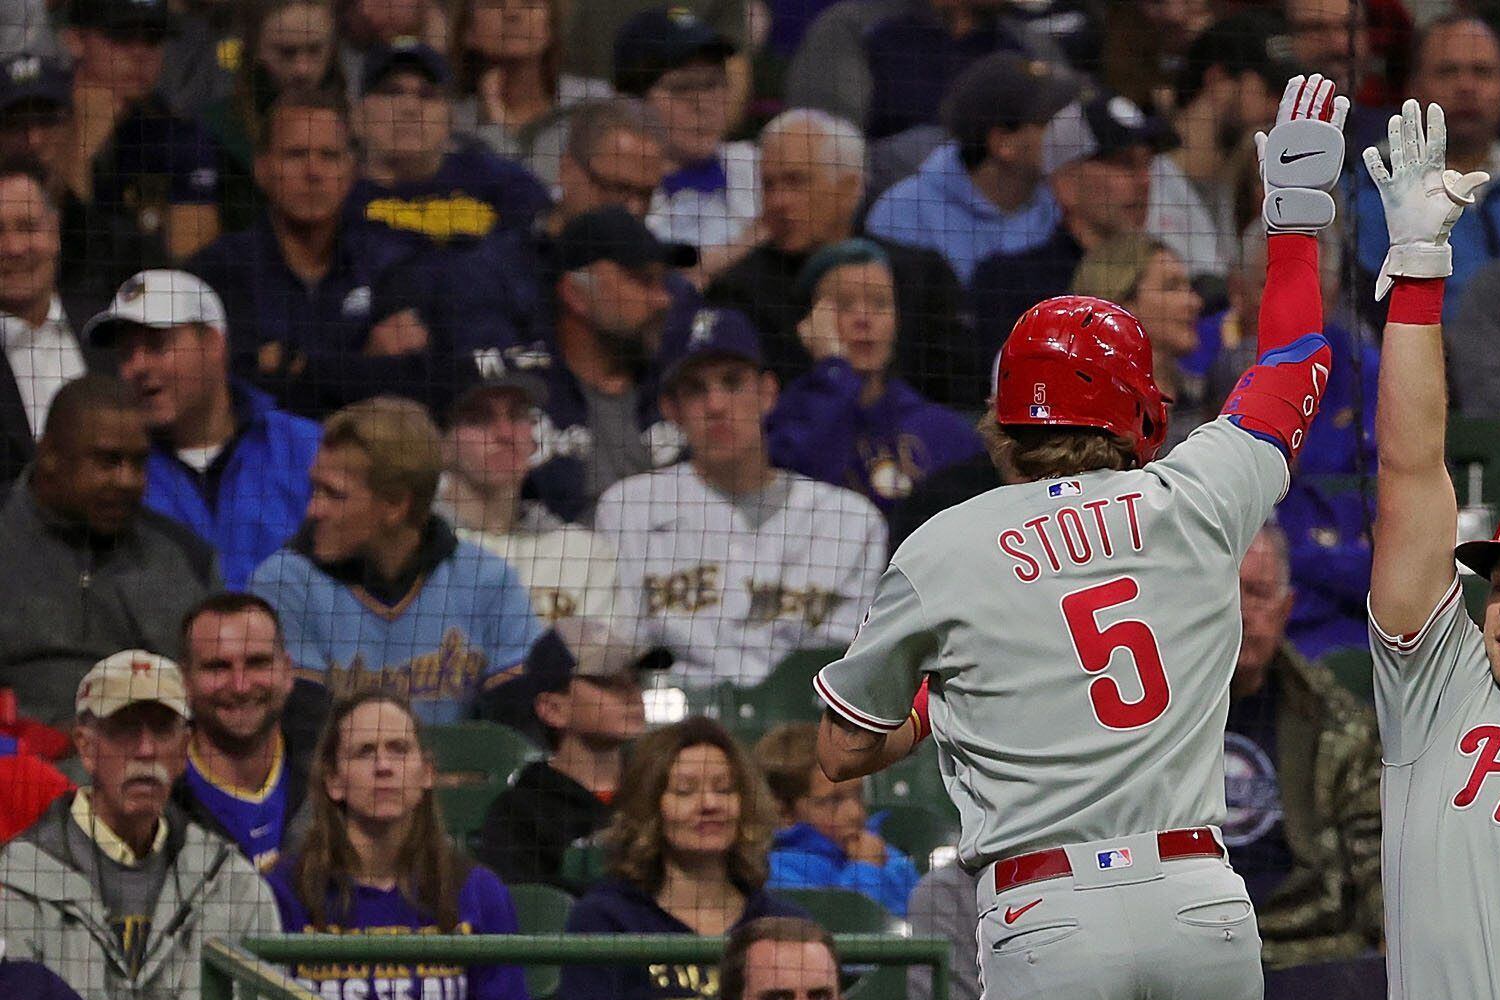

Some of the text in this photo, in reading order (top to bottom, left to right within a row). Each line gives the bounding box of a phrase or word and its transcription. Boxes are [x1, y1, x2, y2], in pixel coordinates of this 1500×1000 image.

[1033, 382, 1046, 405] 5
[998, 492, 1143, 583] STOTT
[1060, 574, 1171, 732] 5
